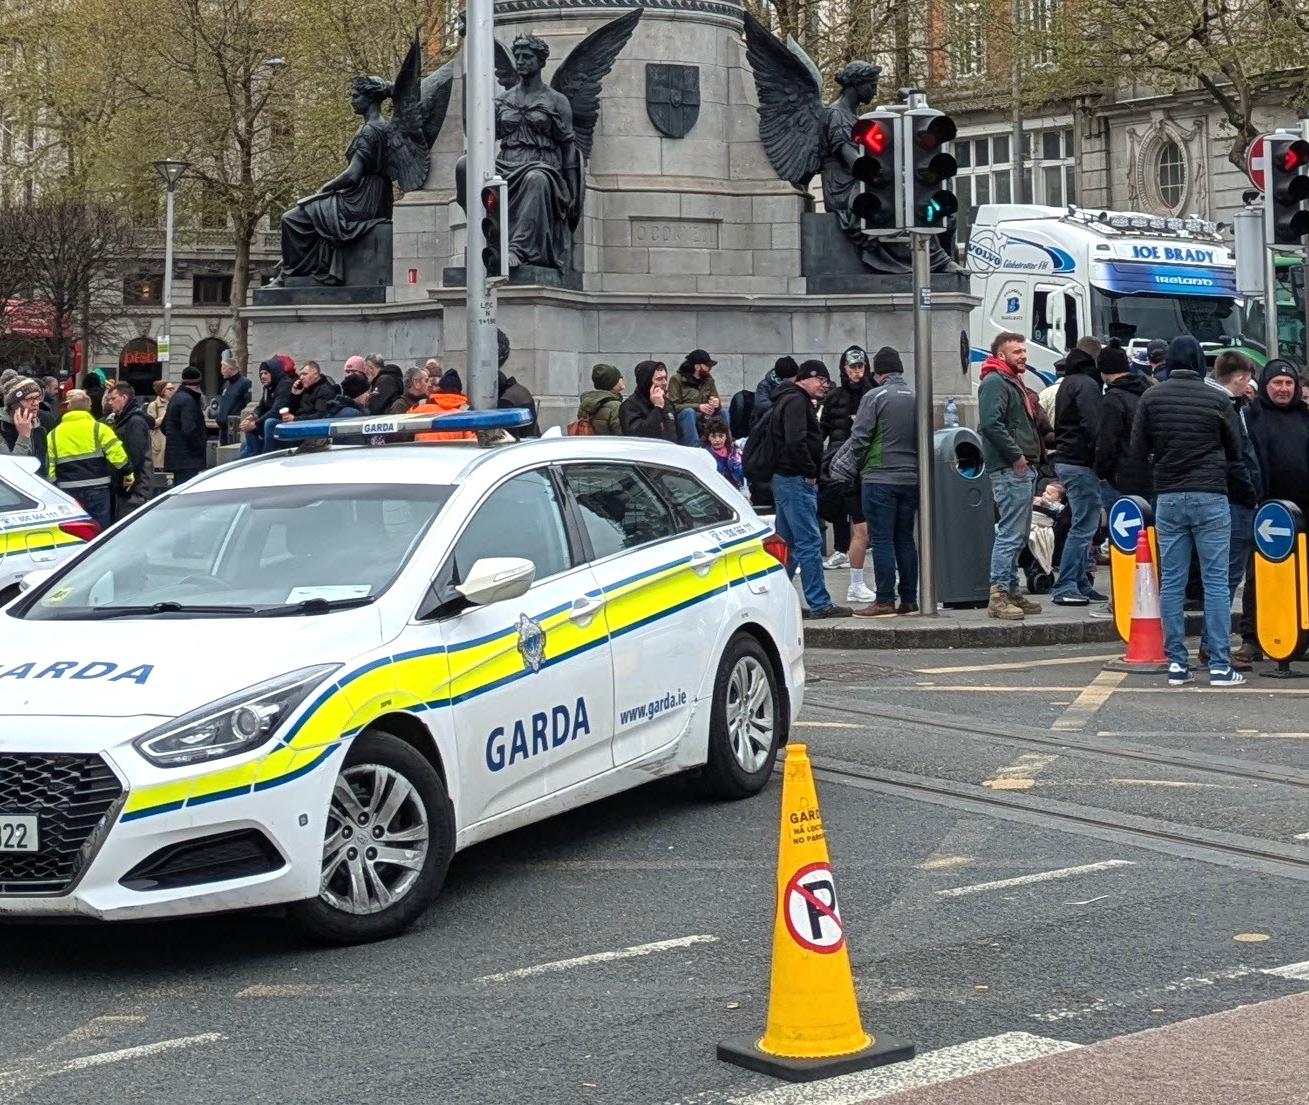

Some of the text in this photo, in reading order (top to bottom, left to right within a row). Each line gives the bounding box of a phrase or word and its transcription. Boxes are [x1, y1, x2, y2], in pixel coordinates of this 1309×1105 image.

[968, 242, 1002, 266] VOLVO
[1132, 244, 1214, 264] JOE BRADY
[364, 422, 395, 433] GARDA
[485, 688, 687, 773] GARDA www.garda.ie
[793, 837, 805, 845] NO
